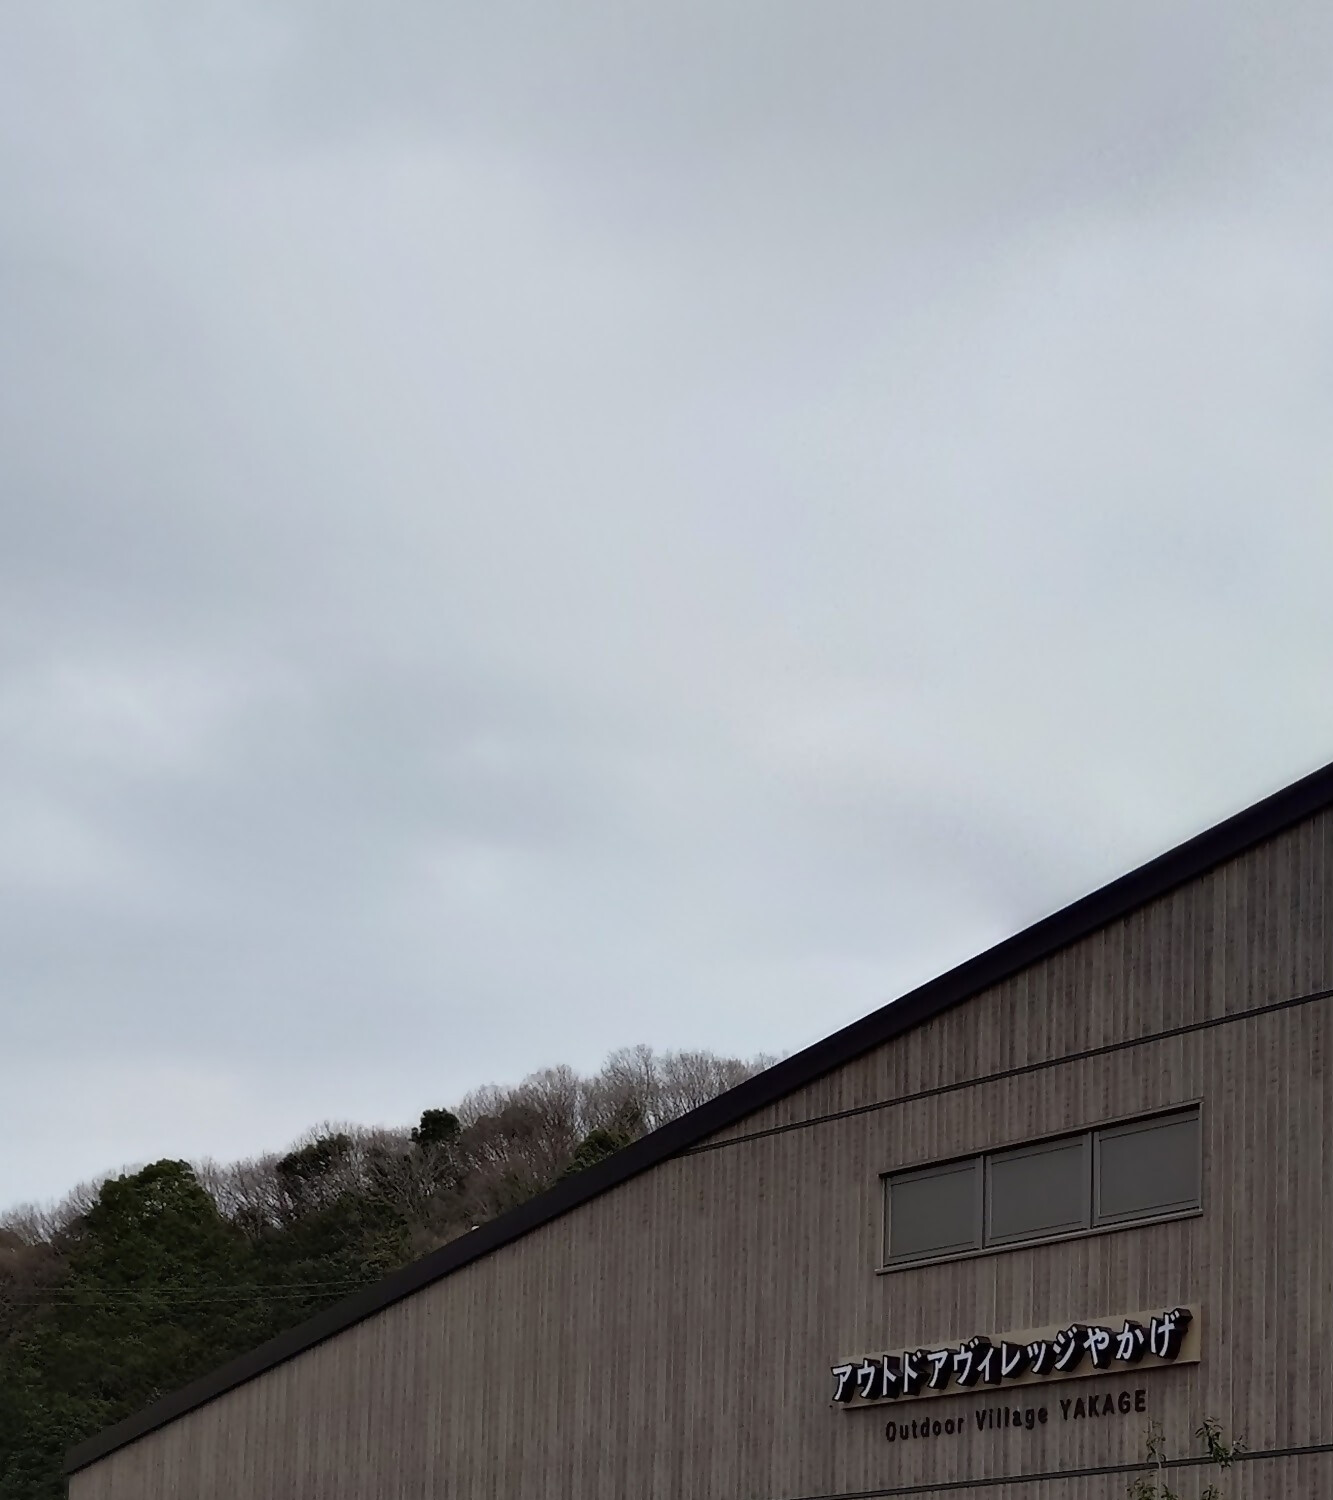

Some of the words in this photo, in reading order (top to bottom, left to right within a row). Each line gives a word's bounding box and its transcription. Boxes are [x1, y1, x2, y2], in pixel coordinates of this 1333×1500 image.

[831, 1309, 1186, 1402] アウトドアヴィレッジやかげ
[885, 1416, 964, 1442] Outdoor
[975, 1406, 1049, 1431] Village
[1059, 1389, 1147, 1420] YAKAGE
